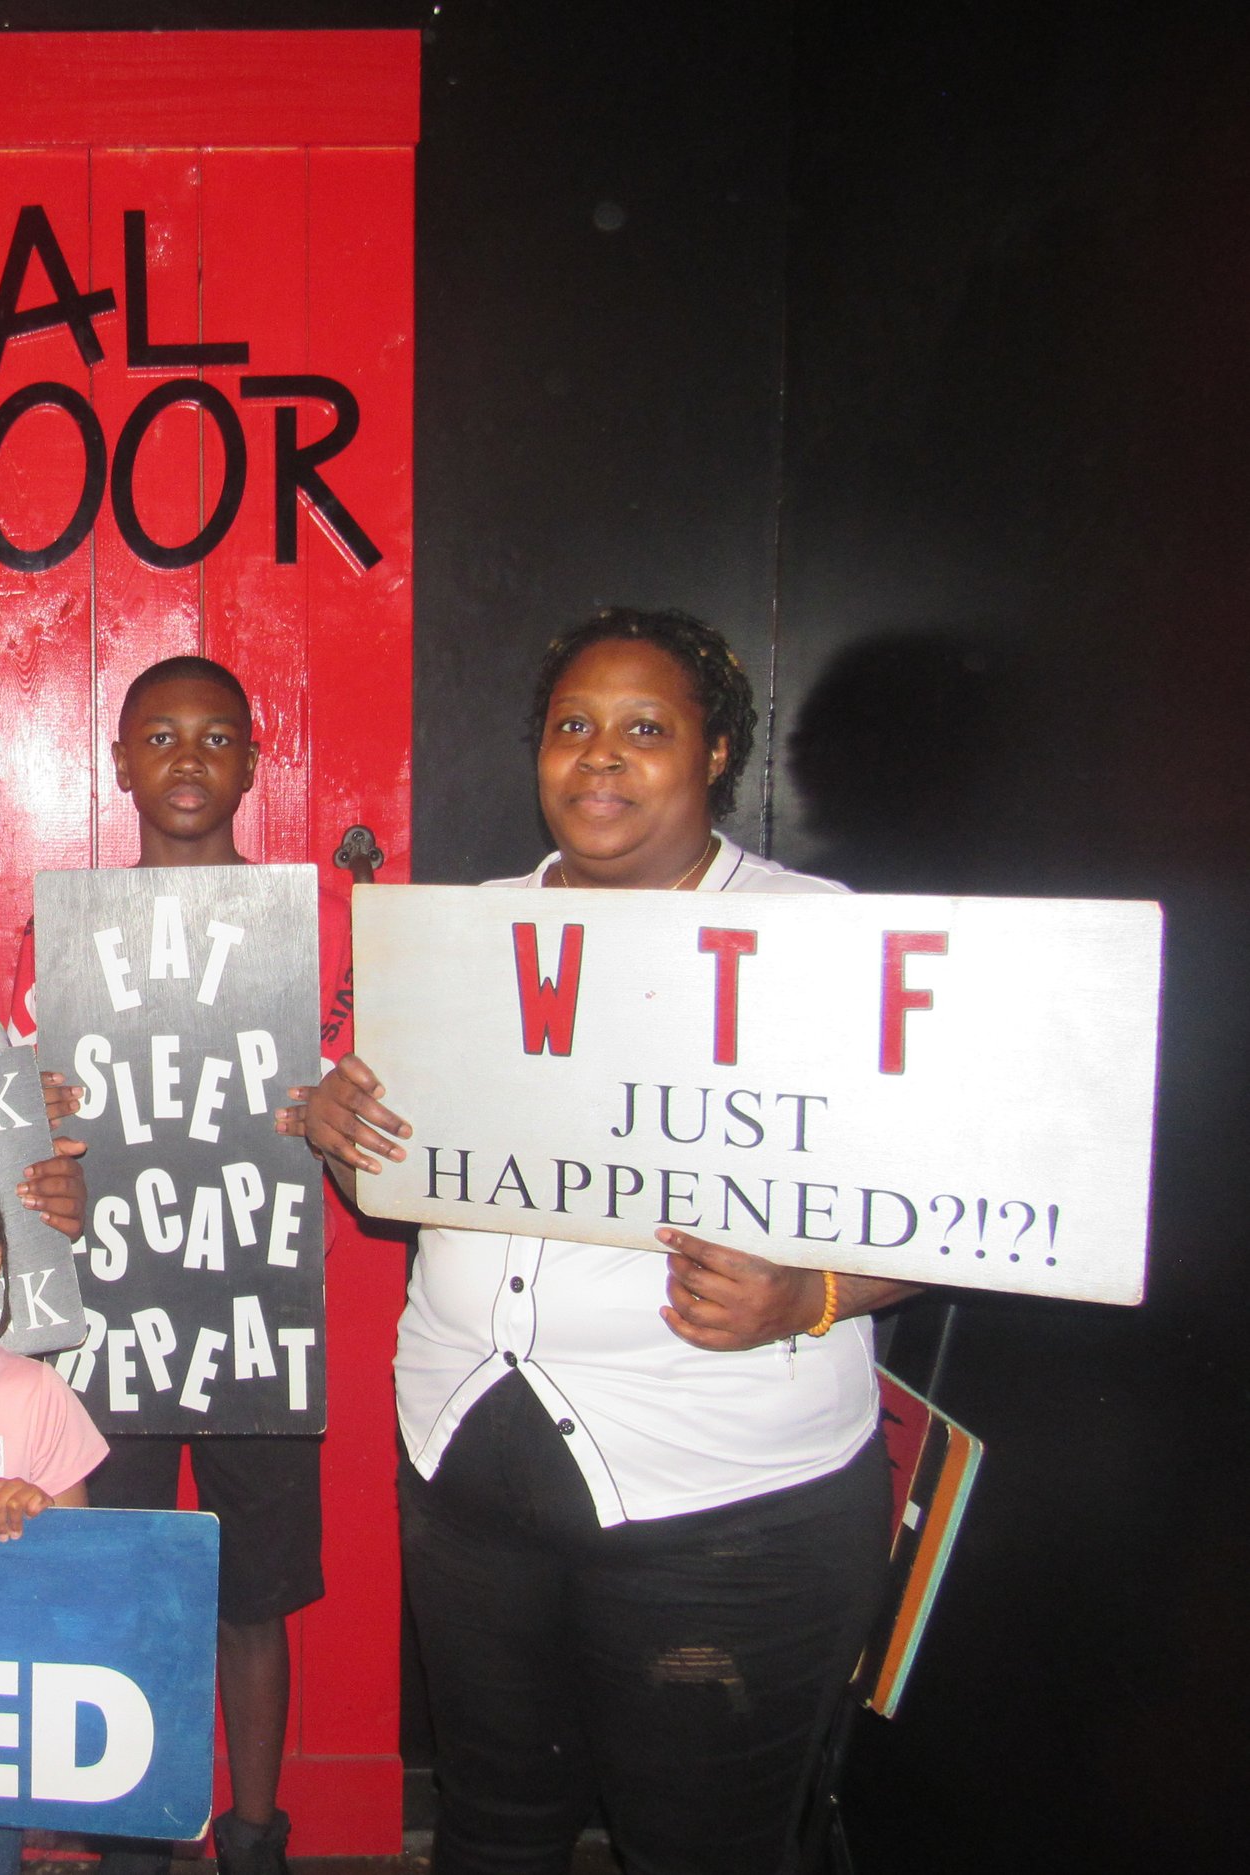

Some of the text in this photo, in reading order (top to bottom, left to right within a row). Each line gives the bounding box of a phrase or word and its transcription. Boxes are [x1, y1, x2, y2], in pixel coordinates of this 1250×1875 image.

[93, 896, 244, 1012] EAT
[74, 1030, 279, 1145] SLEEP
[611, 1082, 828, 1153] JUST
[71, 1162, 305, 1281] SCAPE
[422, 1146, 1060, 1267] HAPPENED?!?!
[55, 1296, 315, 1413] REPEAT
